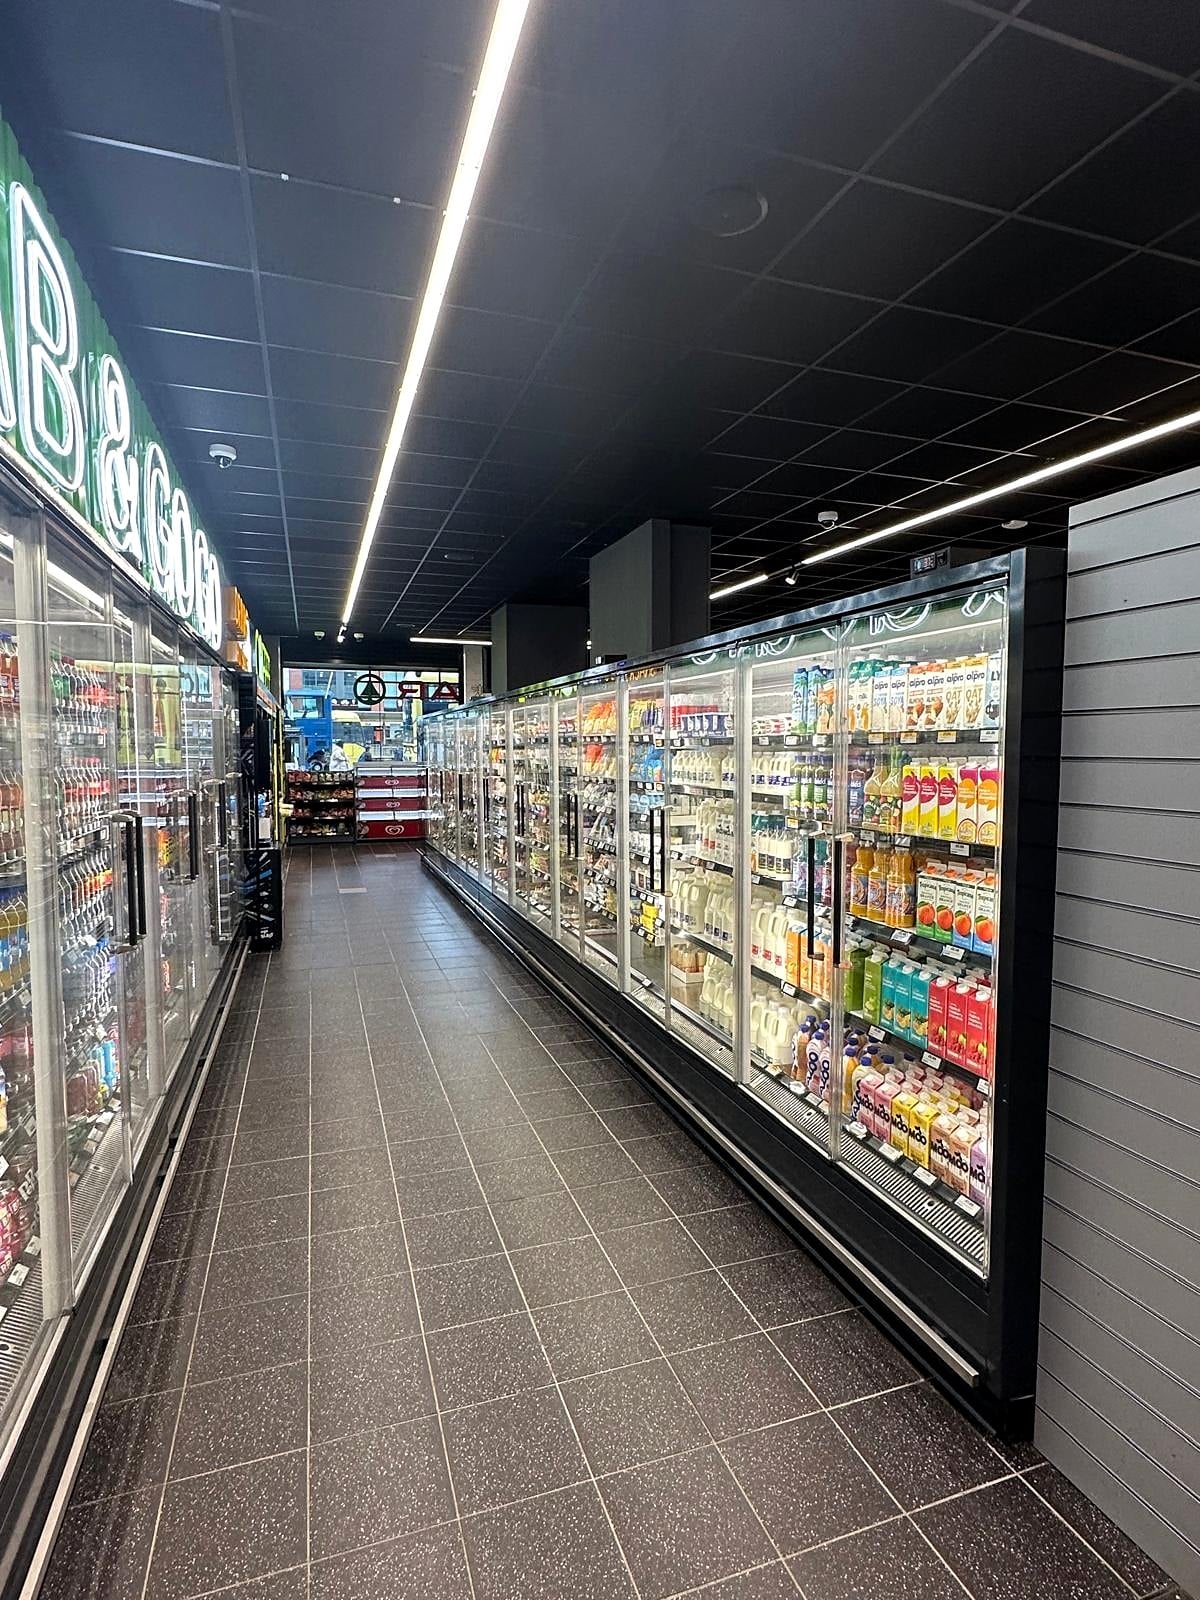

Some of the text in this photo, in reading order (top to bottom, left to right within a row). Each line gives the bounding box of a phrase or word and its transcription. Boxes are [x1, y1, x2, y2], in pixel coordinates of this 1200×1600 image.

[0, 181, 86, 492] B
[909, 677, 926, 689] alpro
[927, 675, 945, 688] alpro
[946, 673, 964, 685] alpro
[966, 670, 985, 684] alpro
[874, 680, 888, 691] alpro
[891, 679, 906, 691] alpro
[945, 689, 962, 702] OAT
[965, 688, 984, 702] OAT
[874, 1104, 891, 1124] MOO
[891, 1114, 908, 1134] MOO
[908, 1126, 927, 1147] MOO
[931, 1138, 950, 1160] MOO
[949, 1152, 969, 1173] MOO
